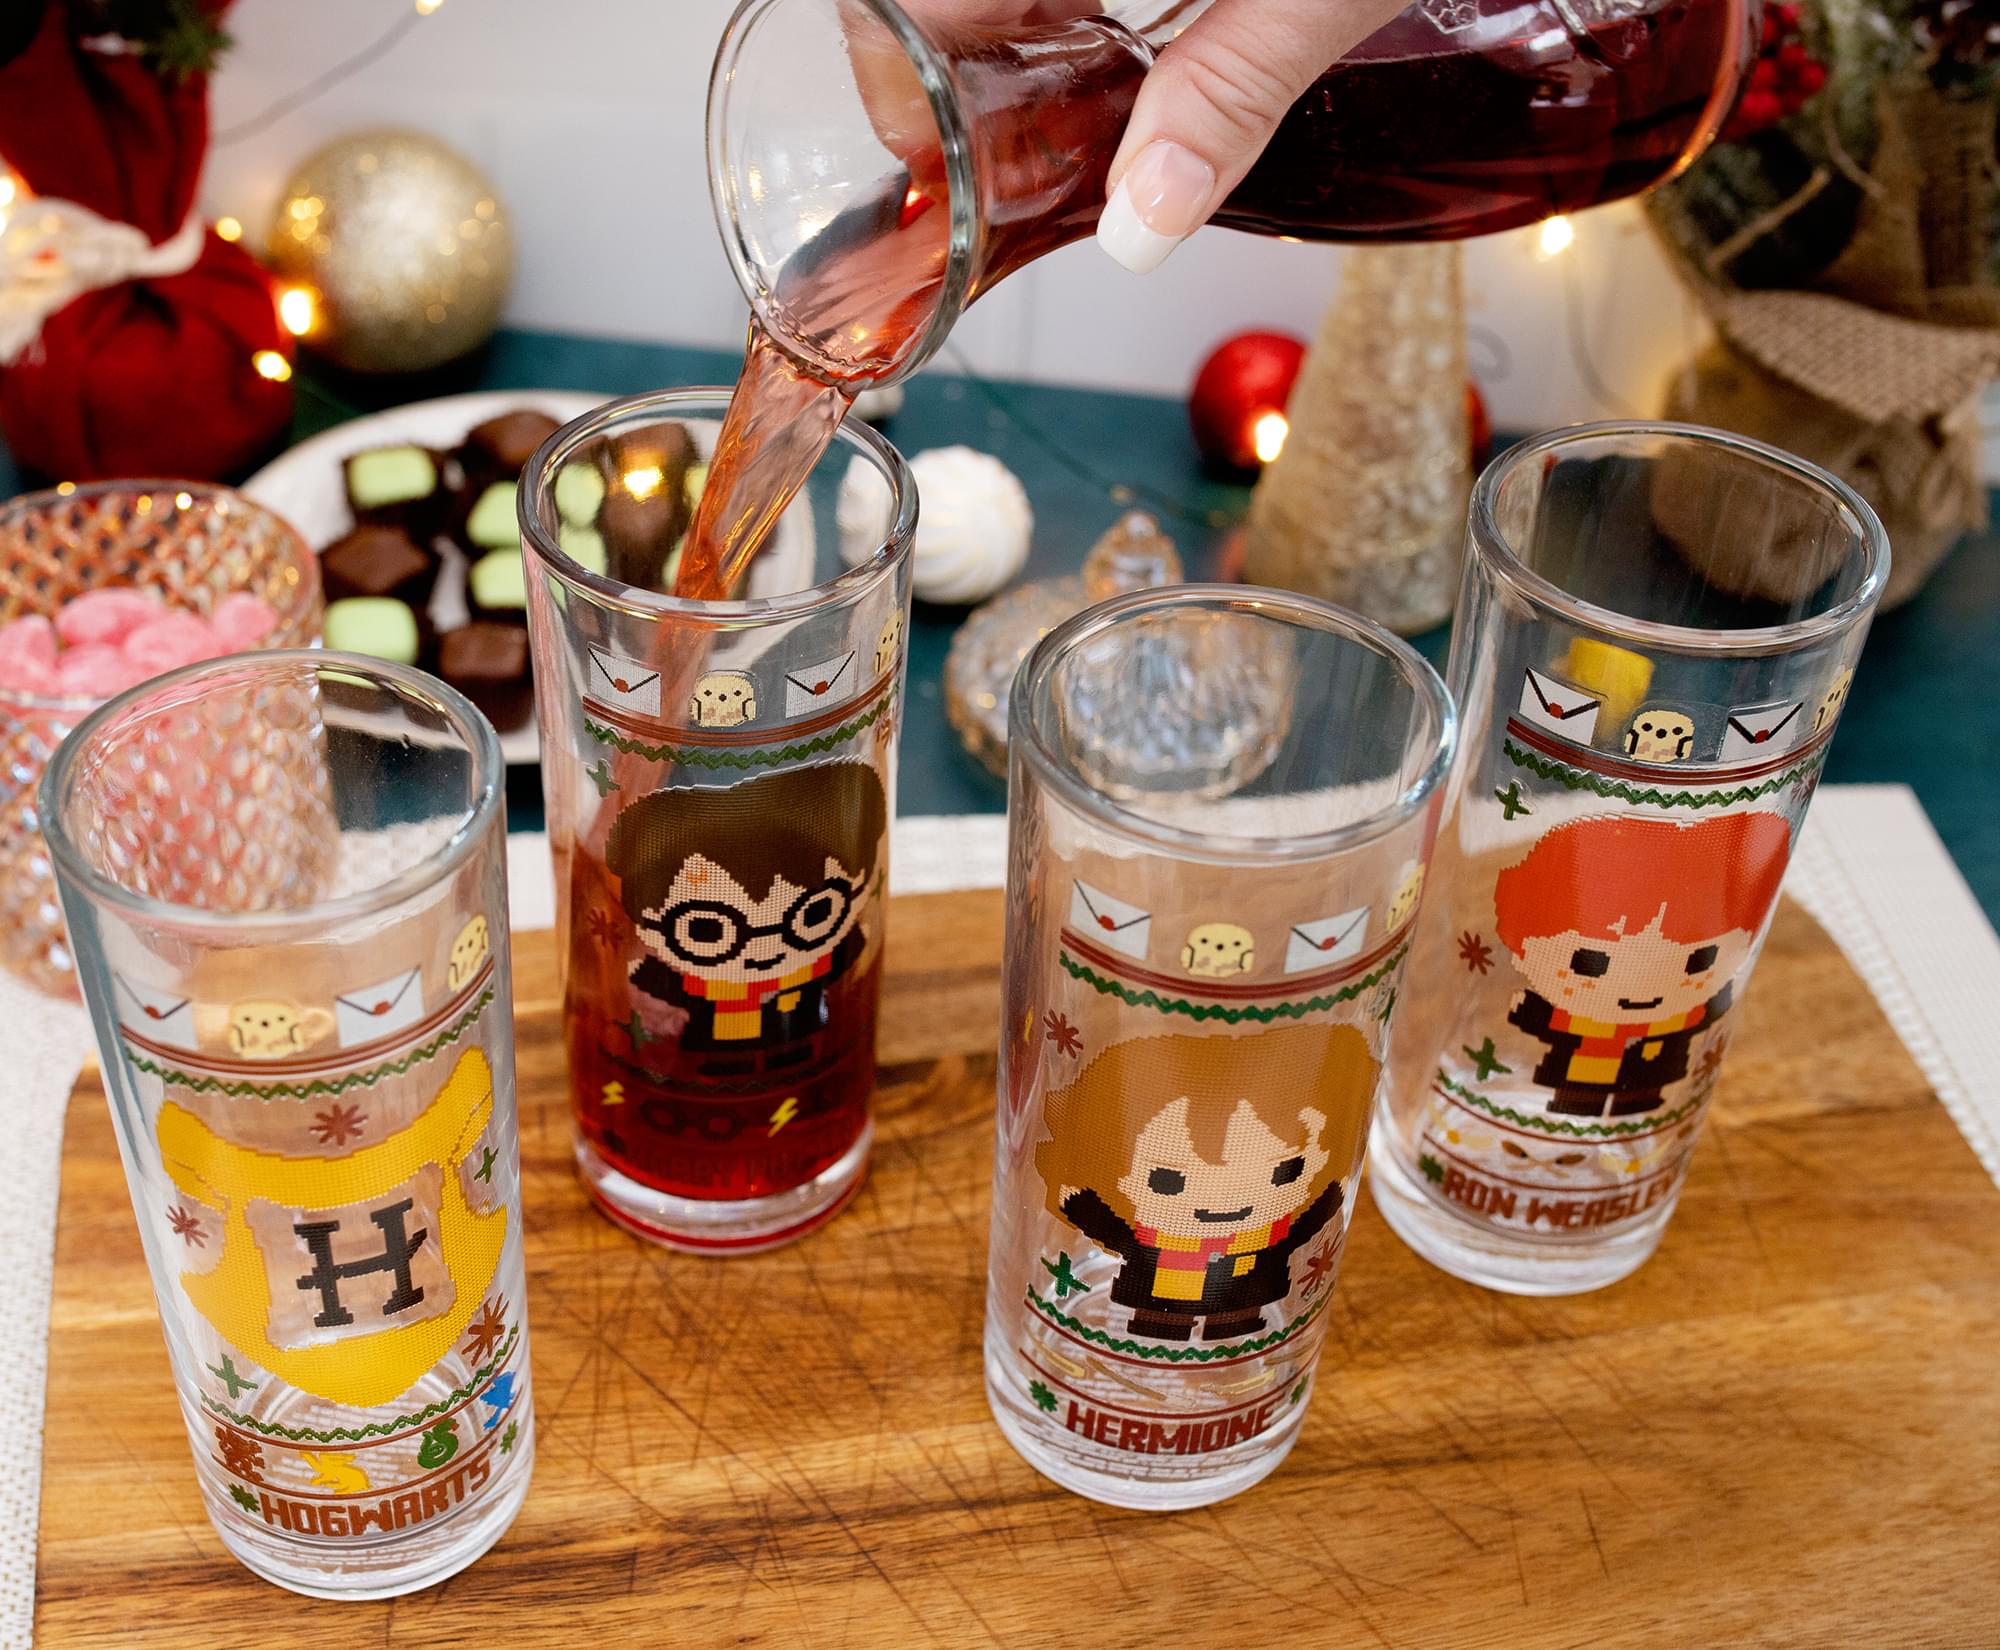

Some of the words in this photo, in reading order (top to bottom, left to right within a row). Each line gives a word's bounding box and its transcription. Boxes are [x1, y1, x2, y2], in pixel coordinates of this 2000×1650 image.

[1442, 1166, 1518, 1220] RON
[293, 1196, 428, 1328] H
[1065, 1390, 1287, 1456] HERMIONE
[258, 1438, 498, 1537] HOGWARTS
